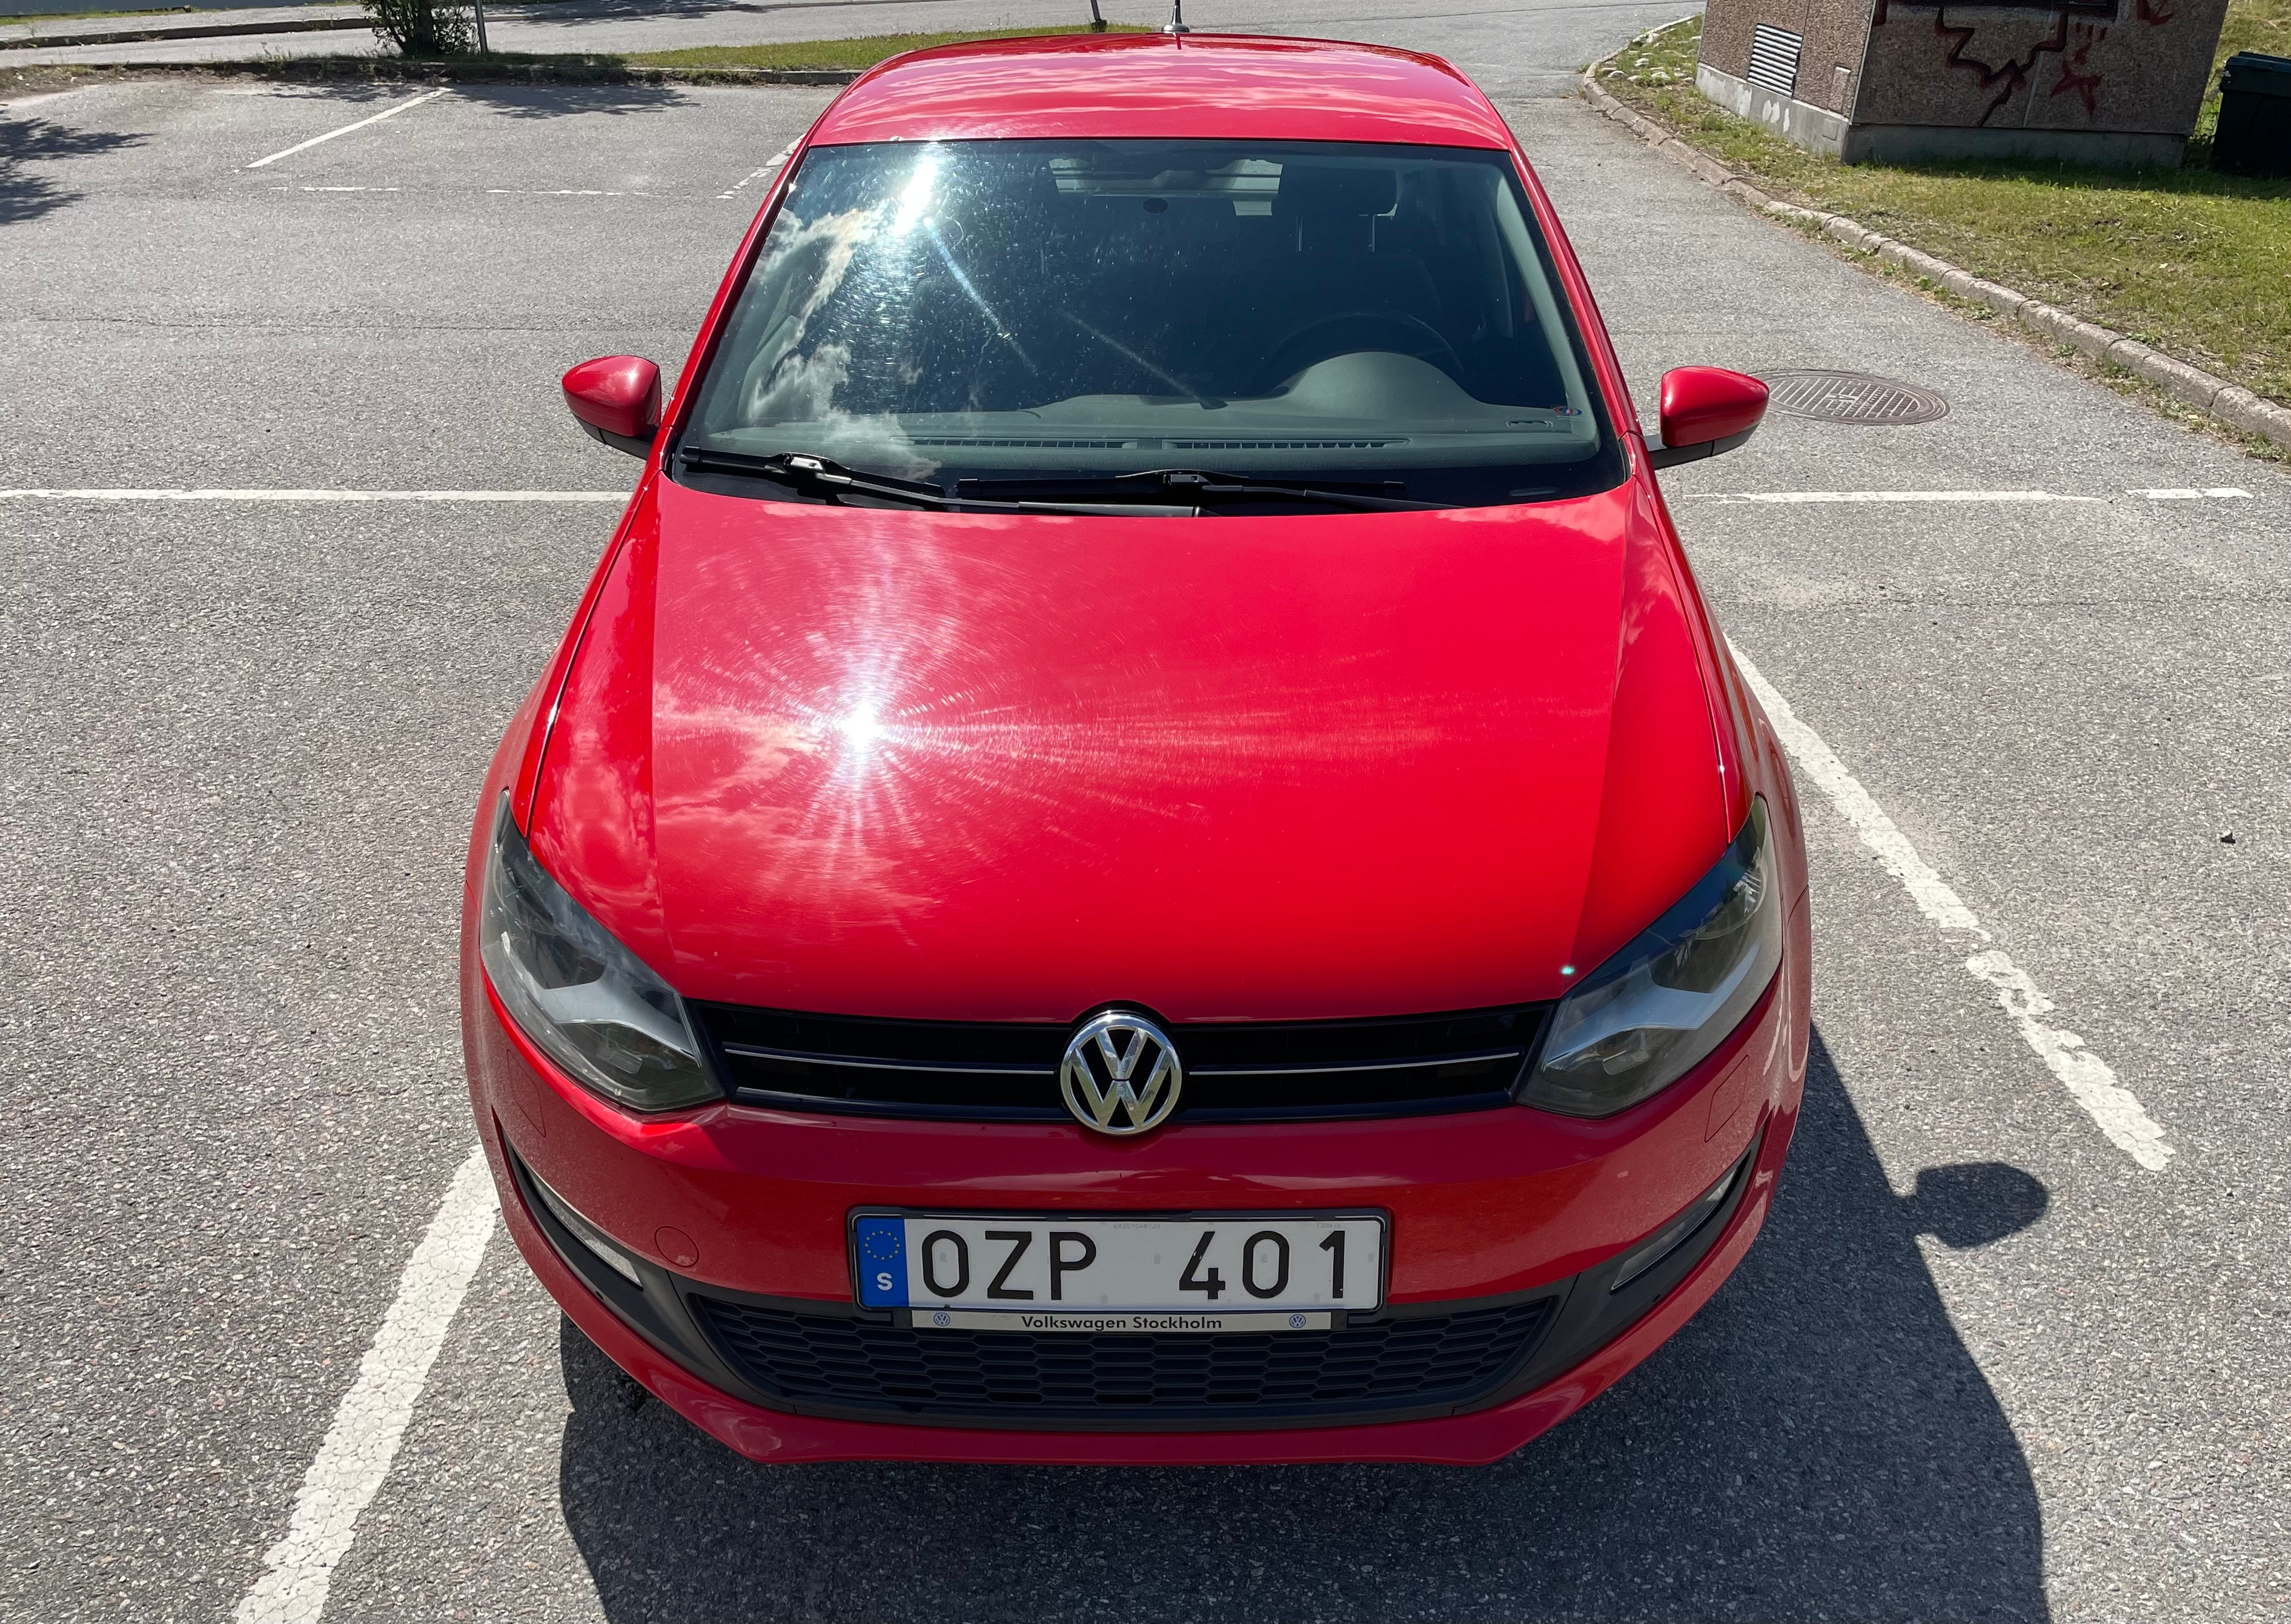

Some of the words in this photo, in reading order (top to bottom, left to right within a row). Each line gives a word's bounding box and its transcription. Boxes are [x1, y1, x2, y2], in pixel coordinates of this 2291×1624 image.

[1065, 1020, 1178, 1132] VW
[876, 1272, 894, 1291] S
[921, 1229, 1097, 1301] OZP
[1178, 1230, 1345, 1300] 401
[1021, 1315, 1127, 1331] Volkswagen
[1132, 1316, 1222, 1329] Stockholm
